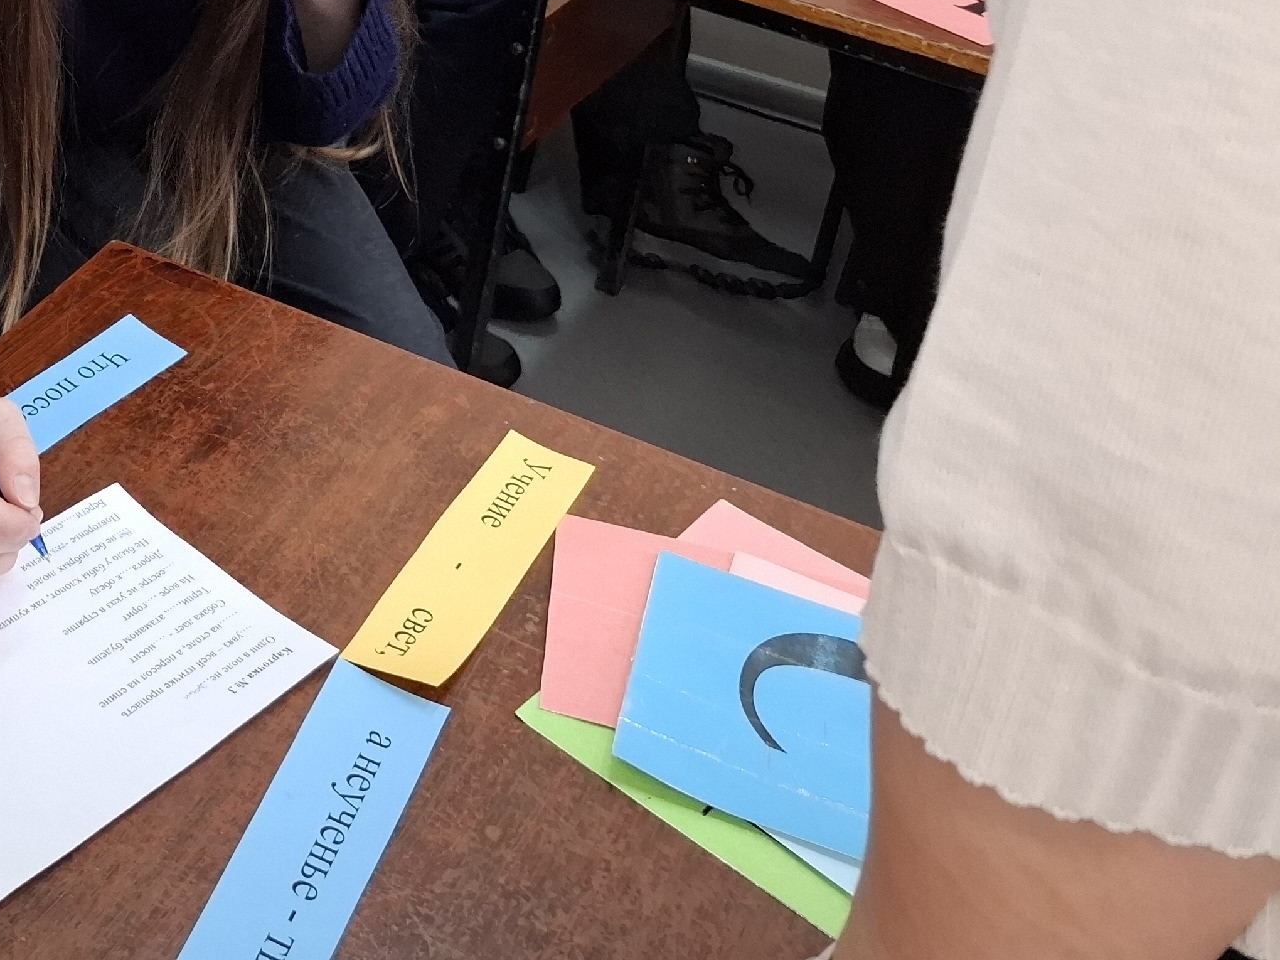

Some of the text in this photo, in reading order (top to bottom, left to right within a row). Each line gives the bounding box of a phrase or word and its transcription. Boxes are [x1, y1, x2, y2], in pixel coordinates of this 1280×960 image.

[76, 351, 131, 379] Что
[479, 457, 553, 528] Учение
[68, 511, 121, 544] Повторенье
[89, 541, 107, 553] без
[110, 545, 137, 561] было
[132, 536, 150, 548] Не
[55, 548, 90, 573] добрых
[25, 568, 57, 591] людей
[157, 581, 180, 597] воре
[177, 572, 196, 585] На
[125, 585, 139, 596] не
[28, 597, 48, 611] так
[191, 598, 226, 621] Собака
[61, 610, 100, 636] стряпне
[121, 612, 166, 644] атаманом
[373, 607, 434, 657] свет,
[86, 641, 125, 665] будешь
[241, 650, 251, 658] в
[248, 634, 276, 654] Один
[139, 652, 178, 681] пересол
[194, 649, 218, 669] всей
[220, 655, 244, 673] поле
[245, 645, 294, 679] Карточка
[162, 664, 197, 689] птичке
[97, 686, 128, 708] спине
[226, 684, 238, 694] 3
[119, 686, 165, 718] пропасть
[364, 729, 392, 749] а
[290, 751, 382, 901] неученье
